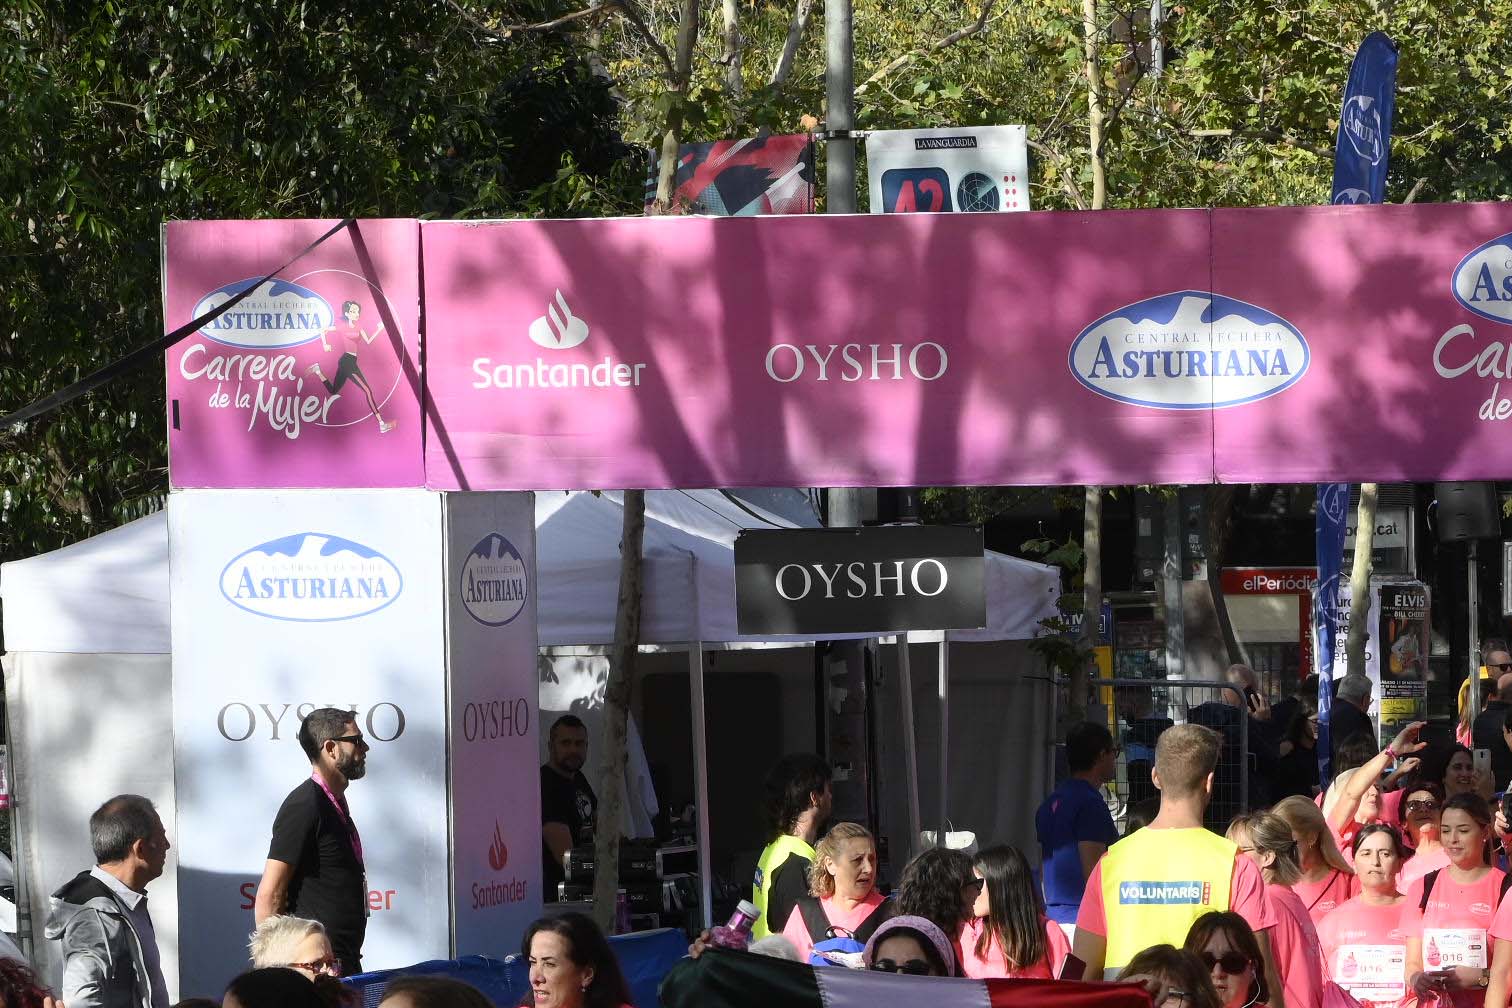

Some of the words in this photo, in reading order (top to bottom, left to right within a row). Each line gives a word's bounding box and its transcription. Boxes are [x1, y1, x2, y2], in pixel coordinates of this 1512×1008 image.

[927, 137, 975, 148] VANGUARDIA
[203, 304, 322, 330] ASTURIANA
[1124, 331, 1199, 344] CENTRAL
[1206, 331, 1285, 344] LECHERA
[179, 344, 297, 381] Carrera
[472, 356, 647, 389] Santander
[765, 341, 948, 384] OYSHO
[1088, 335, 1291, 381] ASTURIANA
[208, 382, 230, 409] de
[235, 382, 251, 409] la
[248, 377, 341, 440] Mujer
[234, 566, 389, 600] ASTURIANA
[466, 568, 524, 603] ASTURIANA
[775, 557, 948, 601] OYSHO
[1394, 594, 1424, 607] ELVIS
[218, 702, 406, 743] OYO
[463, 697, 530, 743] OYSHO
[471, 877, 528, 911] Santander
[1120, 884, 1200, 901] VOLUNTARIS
